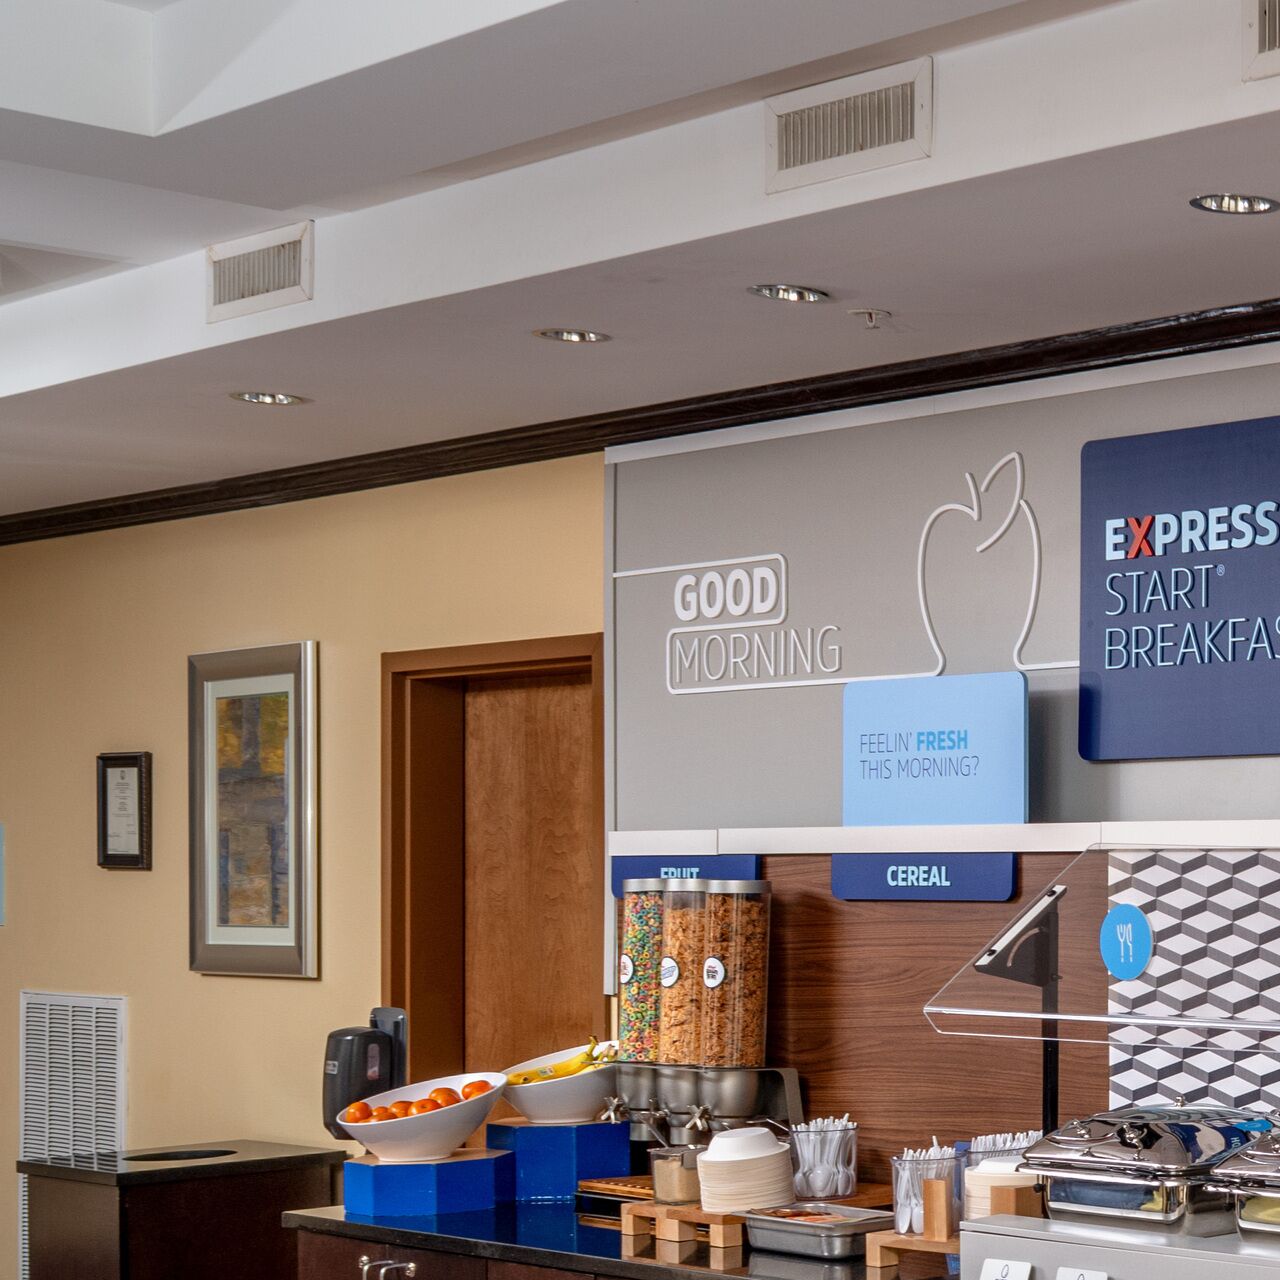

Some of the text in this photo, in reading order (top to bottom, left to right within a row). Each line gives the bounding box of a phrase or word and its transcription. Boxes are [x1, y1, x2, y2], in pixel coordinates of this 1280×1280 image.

[1105, 501, 1280, 561] EXPRESS
[674, 566, 778, 621] GOOD
[675, 625, 842, 683] MORNING
[916, 729, 968, 752] FRESH
[860, 755, 980, 780] THIS MORNING?
[886, 865, 951, 887] CEREAL
